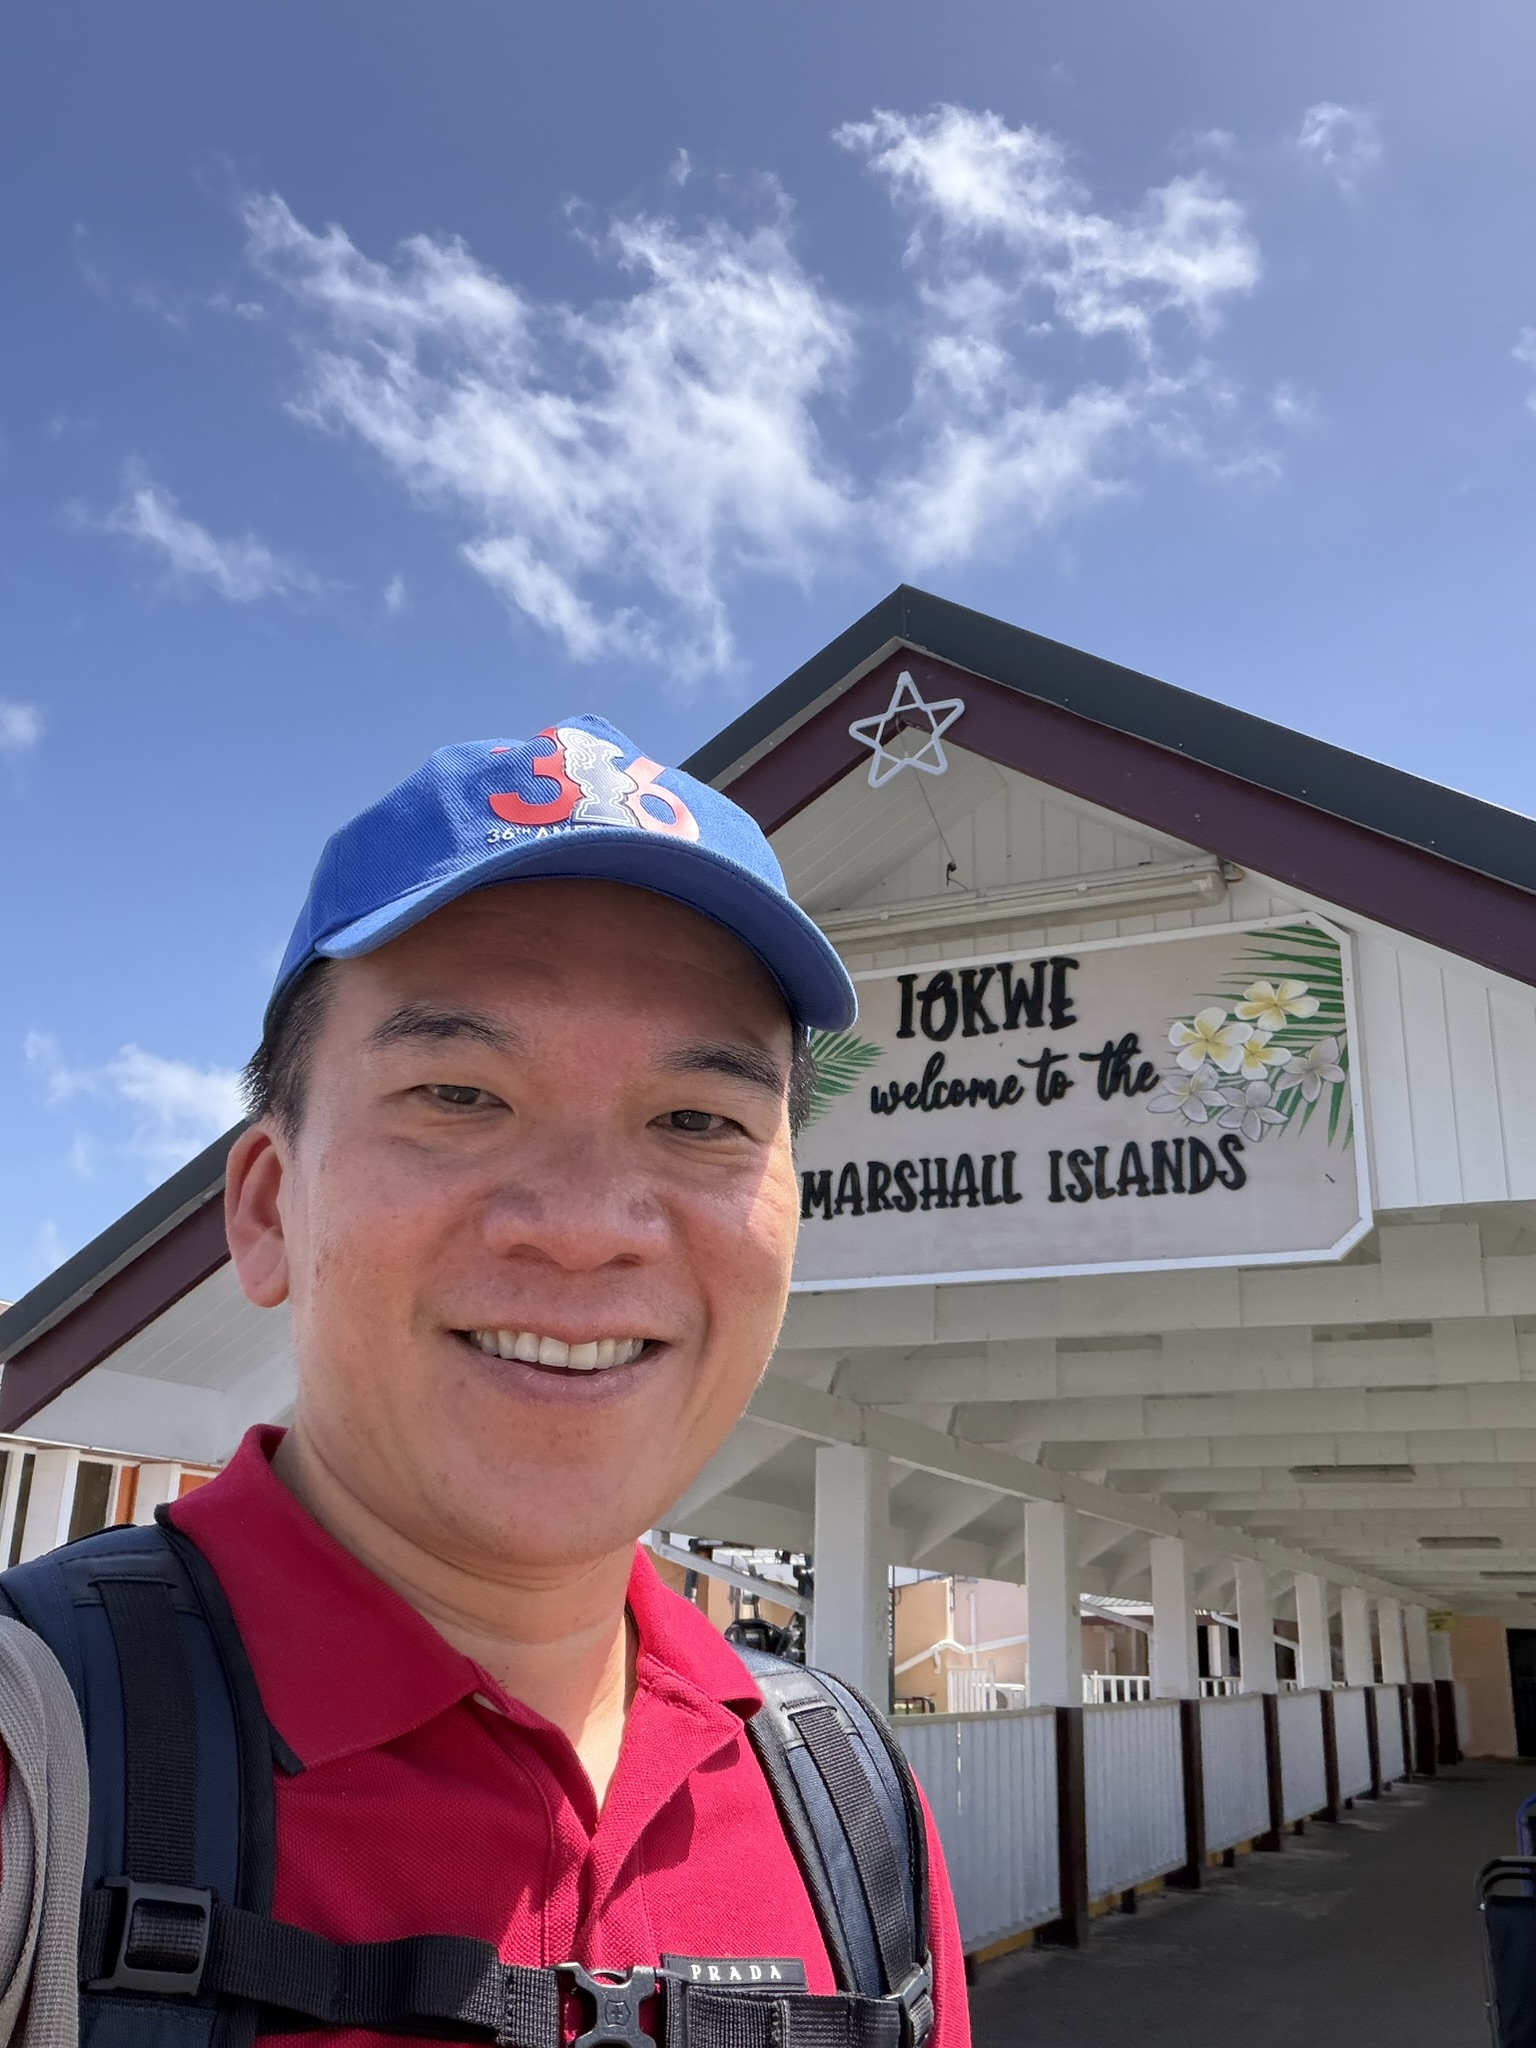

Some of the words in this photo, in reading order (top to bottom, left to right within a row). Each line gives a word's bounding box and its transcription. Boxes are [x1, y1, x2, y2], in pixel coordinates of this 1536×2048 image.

[897, 957, 1080, 1041] IOKWE
[871, 1052, 1024, 1115] welcome
[1018, 1048, 1074, 1106] to
[1079, 1033, 1160, 1100] the
[801, 1151, 1023, 1221] MARSHALL
[1049, 1134, 1247, 1203] ISLANDS
[690, 1964, 782, 1981] PRADA
